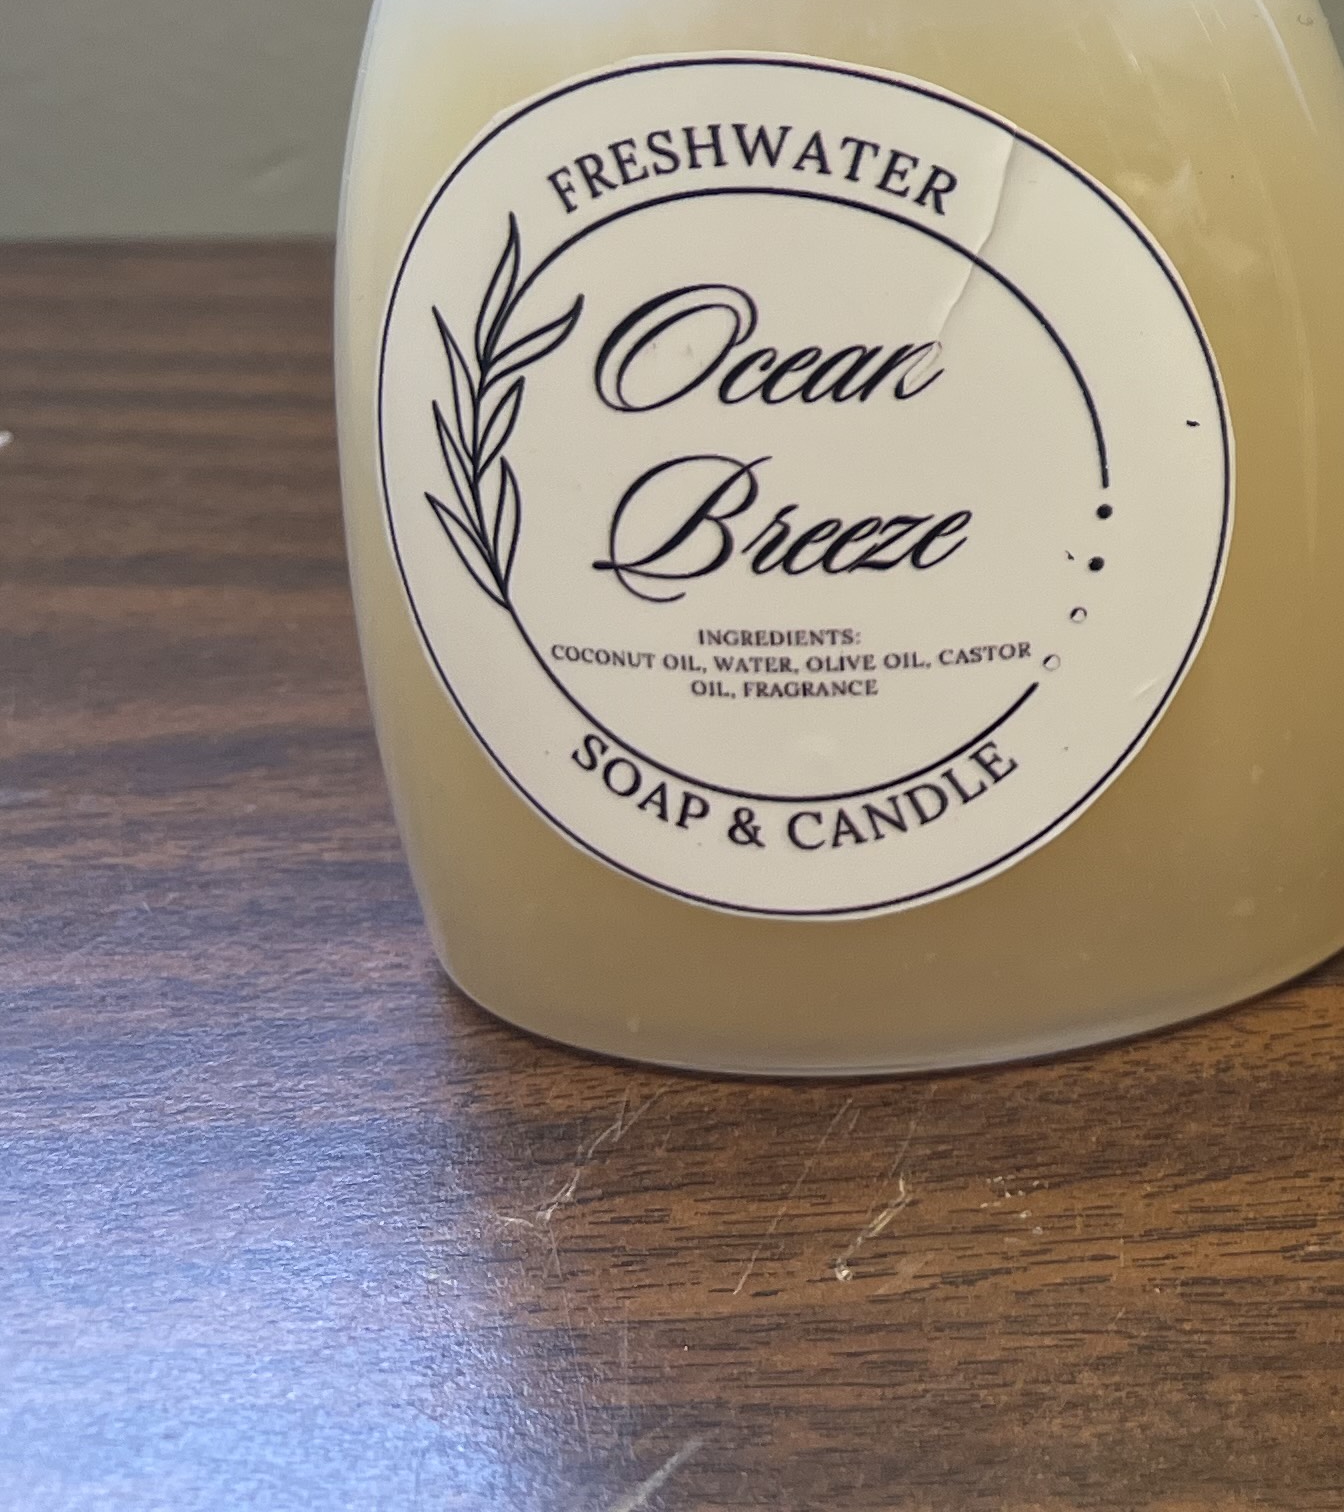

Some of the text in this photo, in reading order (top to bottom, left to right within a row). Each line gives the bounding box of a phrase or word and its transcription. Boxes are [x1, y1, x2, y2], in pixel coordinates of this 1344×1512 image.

[545, 123, 959, 216] FRESHWATER
[594, 283, 945, 412] Ocean
[593, 454, 973, 602] Breeze
[551, 641, 1032, 675] COCONUT OIL, WATER, OLIVE OIL, CASTOR
[698, 628, 862, 647] INGREDIENTS:
[690, 678, 878, 700] OIL, FRAGRANCE
[571, 733, 1019, 851] SOAP & CANDLE
